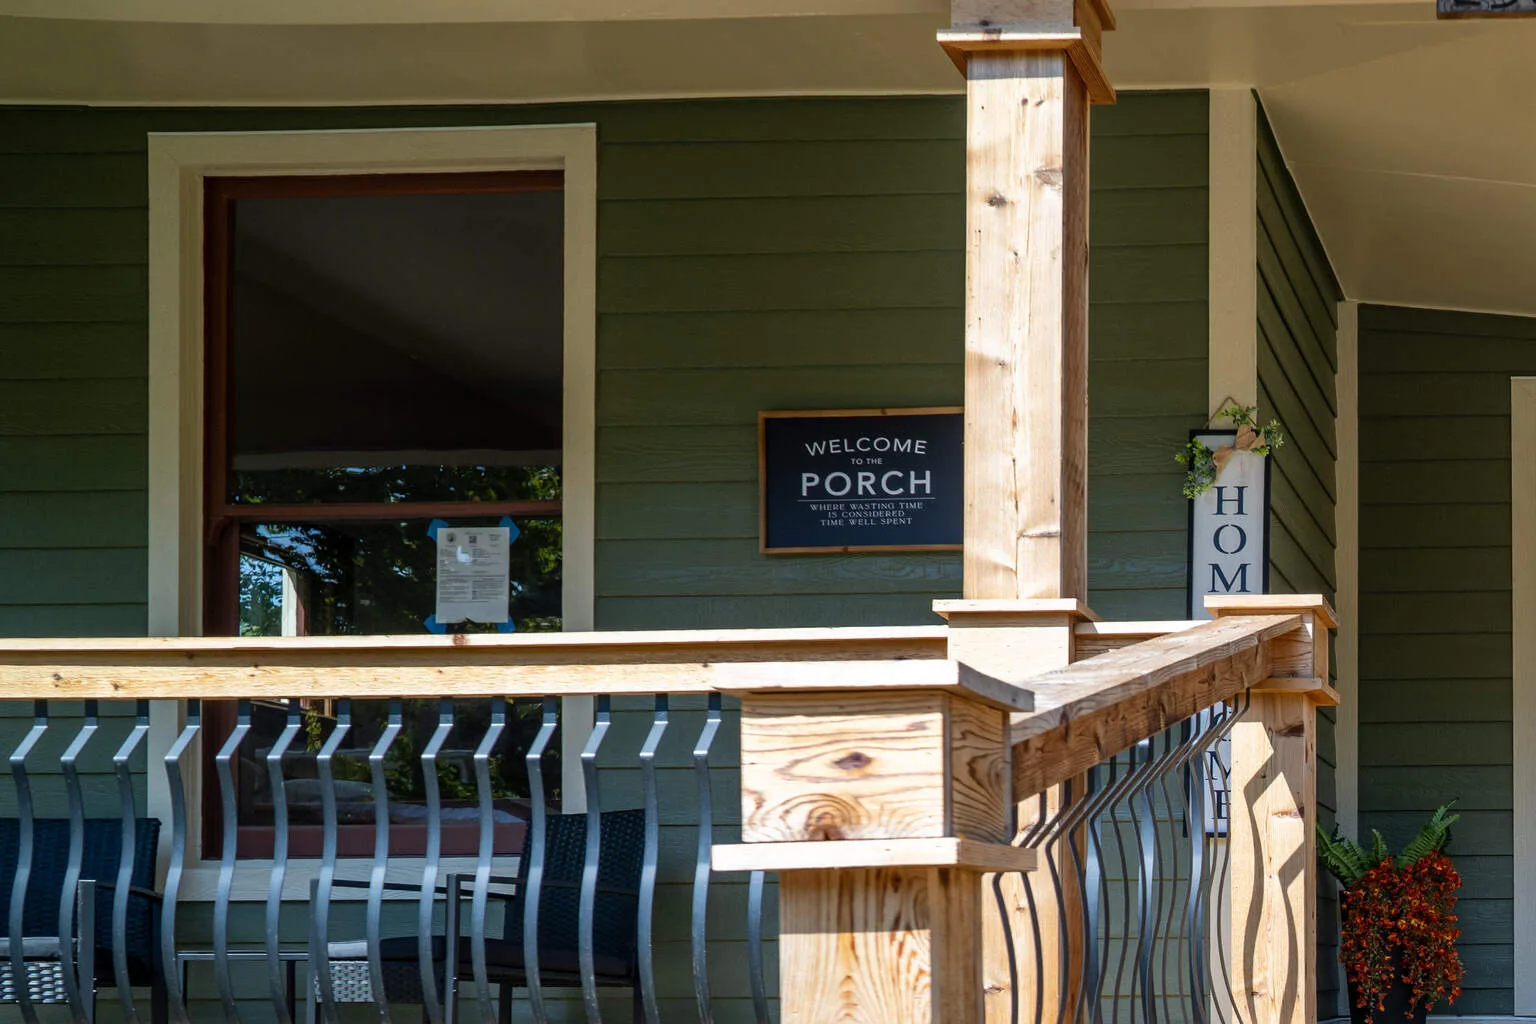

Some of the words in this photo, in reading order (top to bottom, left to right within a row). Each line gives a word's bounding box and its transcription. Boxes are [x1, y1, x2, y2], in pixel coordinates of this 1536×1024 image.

[804, 436, 928, 457] WELCOME
[851, 457, 864, 465] TO
[866, 457, 883, 465] THE
[801, 470, 931, 497] PORCH
[809, 503, 846, 511] WHERE
[850, 502, 895, 510] WASTING
[899, 501, 924, 510] TIME
[828, 511, 838, 519] IS
[841, 510, 905, 518] CONSIDERED
[848, 518, 877, 526] WELL
[880, 517, 913, 525] SPENT
[1207, 485, 1252, 593] HOM
